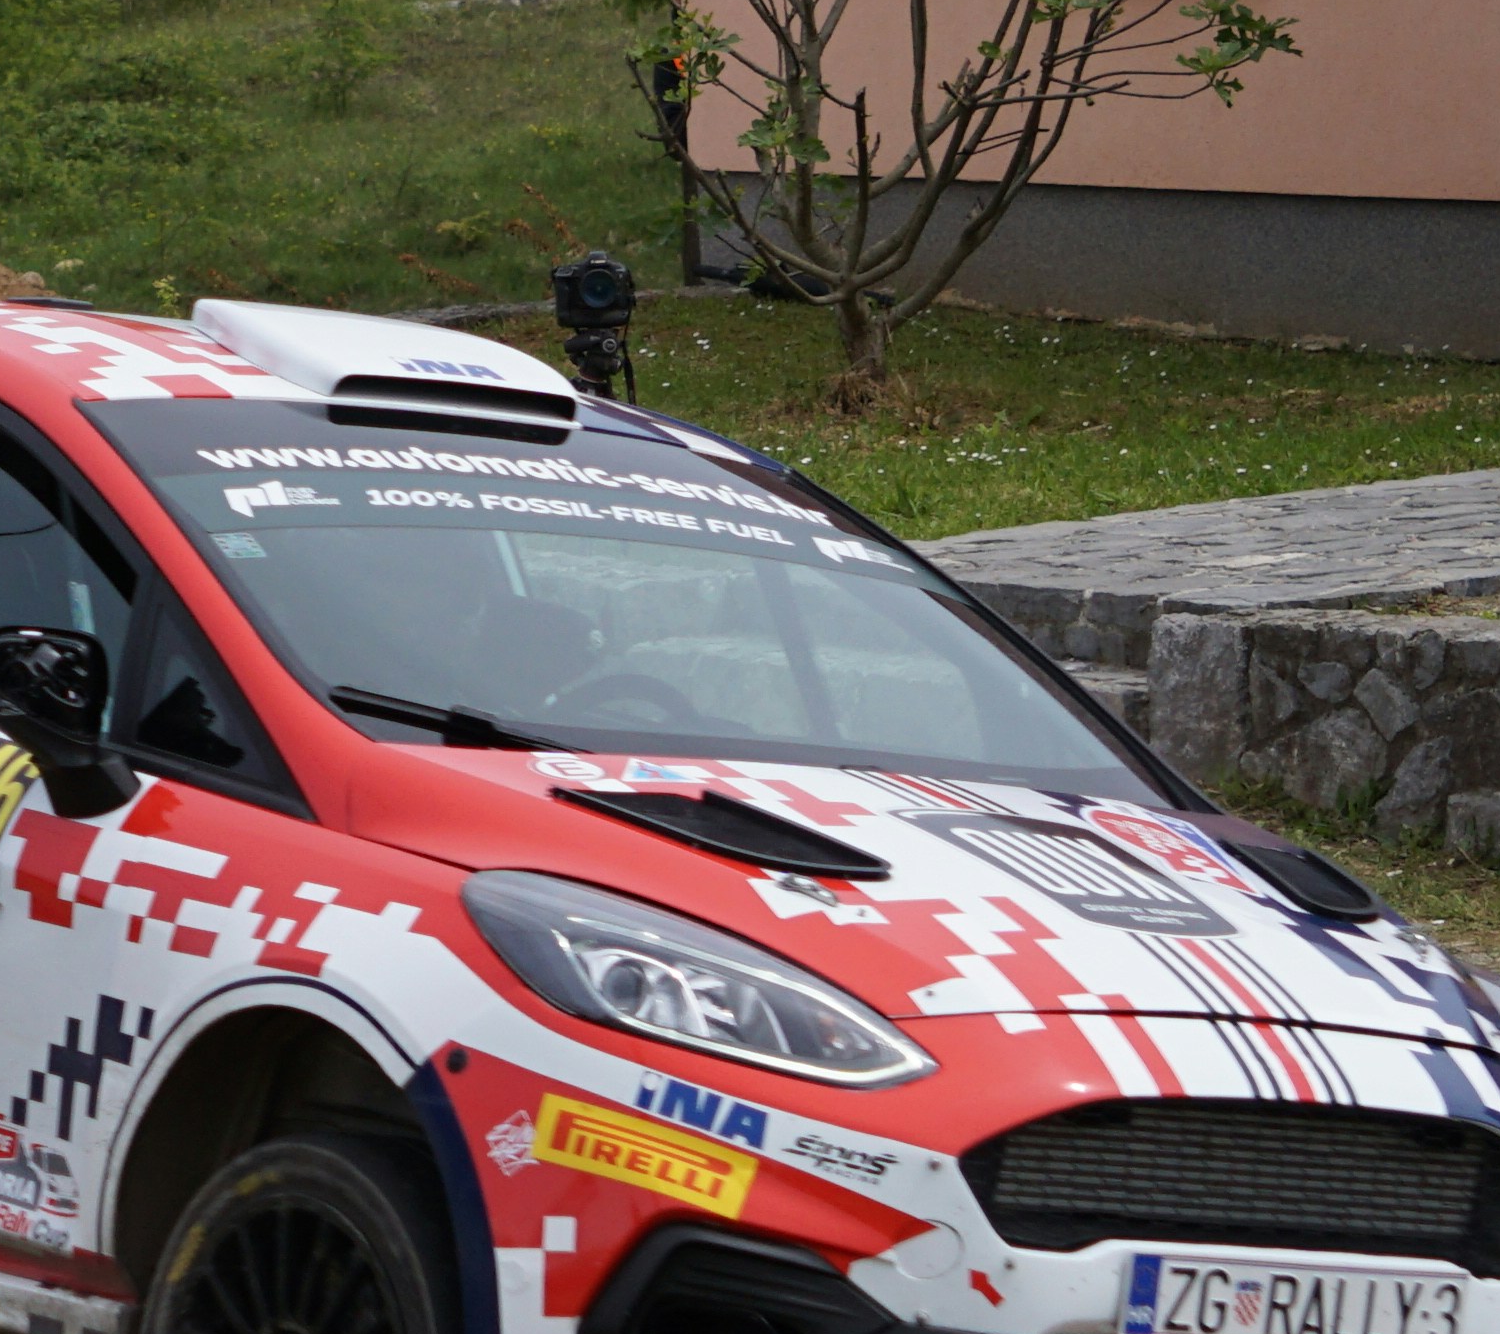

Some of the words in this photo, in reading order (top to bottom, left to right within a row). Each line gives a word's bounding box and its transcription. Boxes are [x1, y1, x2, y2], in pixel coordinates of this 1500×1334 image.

[196, 446, 835, 528] www.automatic-servis.hr
[365, 488, 474, 509] 100%
[478, 492, 702, 531] FOSSIL-FREE
[705, 518, 796, 546] FUEL
[550, 1110, 732, 1200] PIRELLI
[1164, 1267, 1231, 1334] ZG
